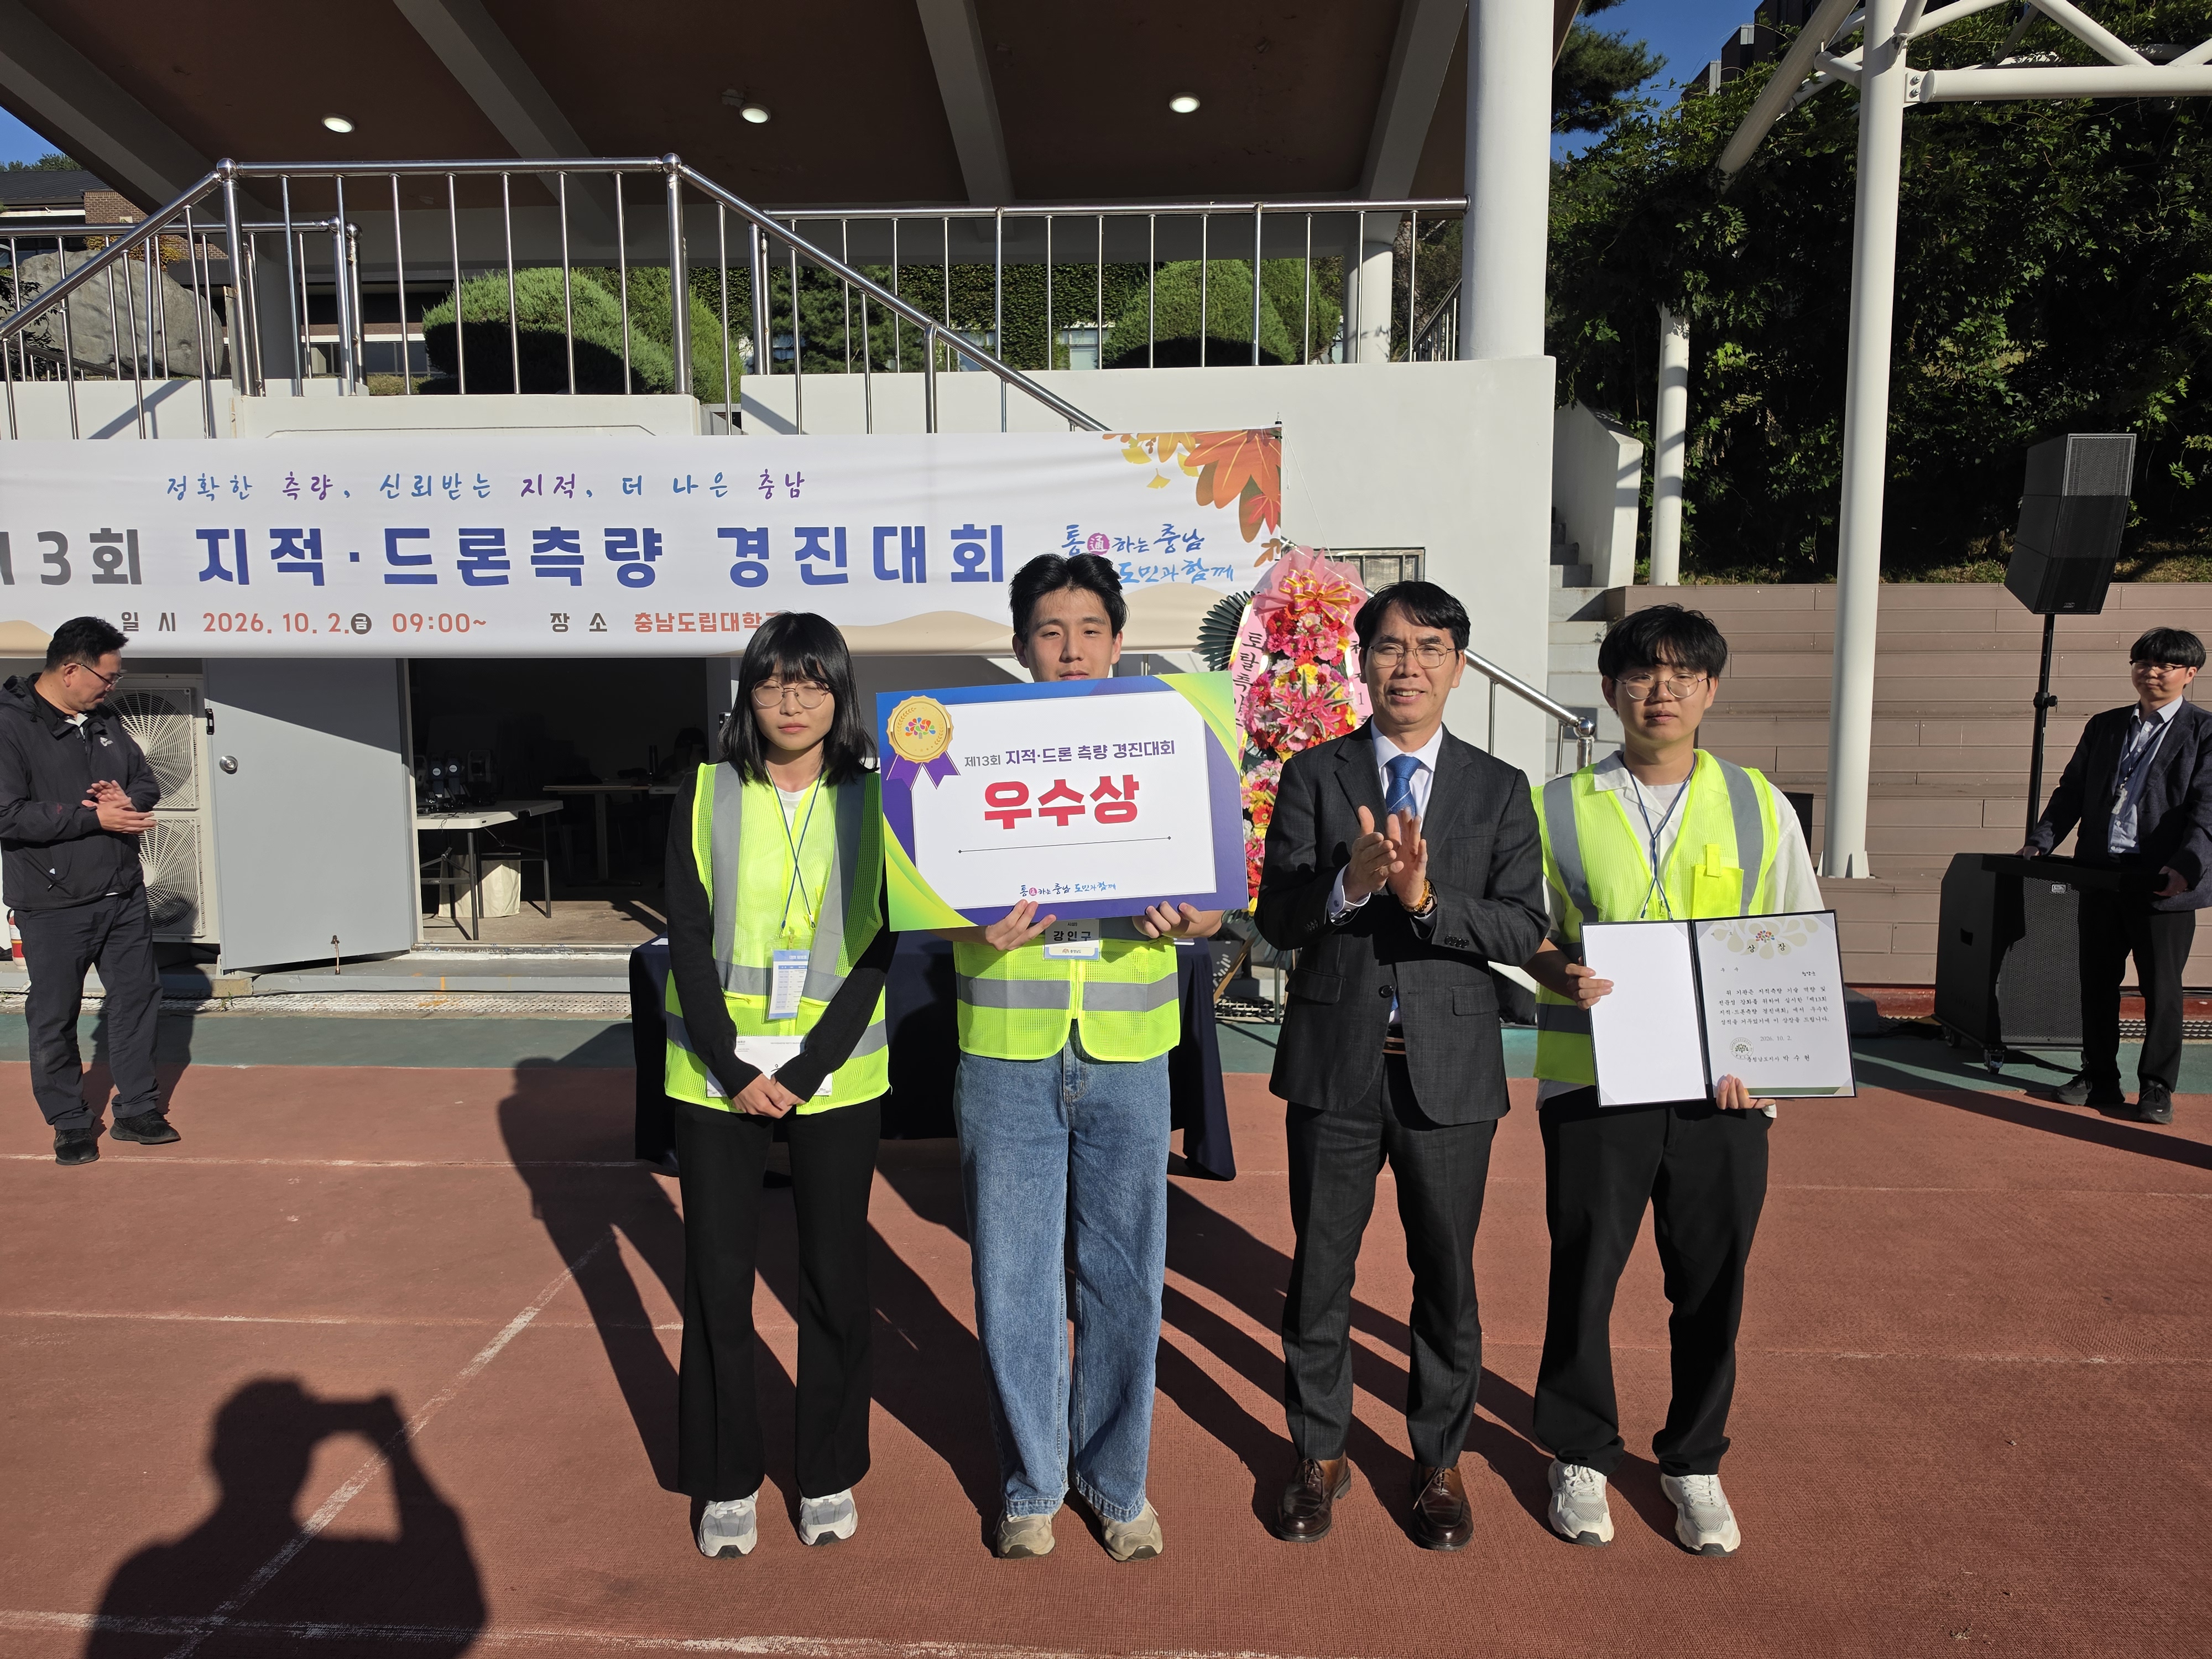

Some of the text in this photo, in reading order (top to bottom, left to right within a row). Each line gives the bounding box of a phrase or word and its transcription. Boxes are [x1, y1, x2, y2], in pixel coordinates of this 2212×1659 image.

[168, 469, 805, 501] 정확한 측량, 신뢰받는 지적, 더 나은 충남
[1153, 524, 1205, 554] 충남
[717, 524, 1005, 588] 경진대회
[1118, 557, 1234, 584] 도민과 함께
[393, 613, 486, 632] 09:00~
[965, 740, 1175, 766] 제13회 지적·드론 측량 경진대회
[984, 774, 1139, 830] 우수상
[1052, 883, 1071, 894] 충남
[1074, 884, 1098, 893] 도민과
[1097, 881, 1115, 891] 함께
